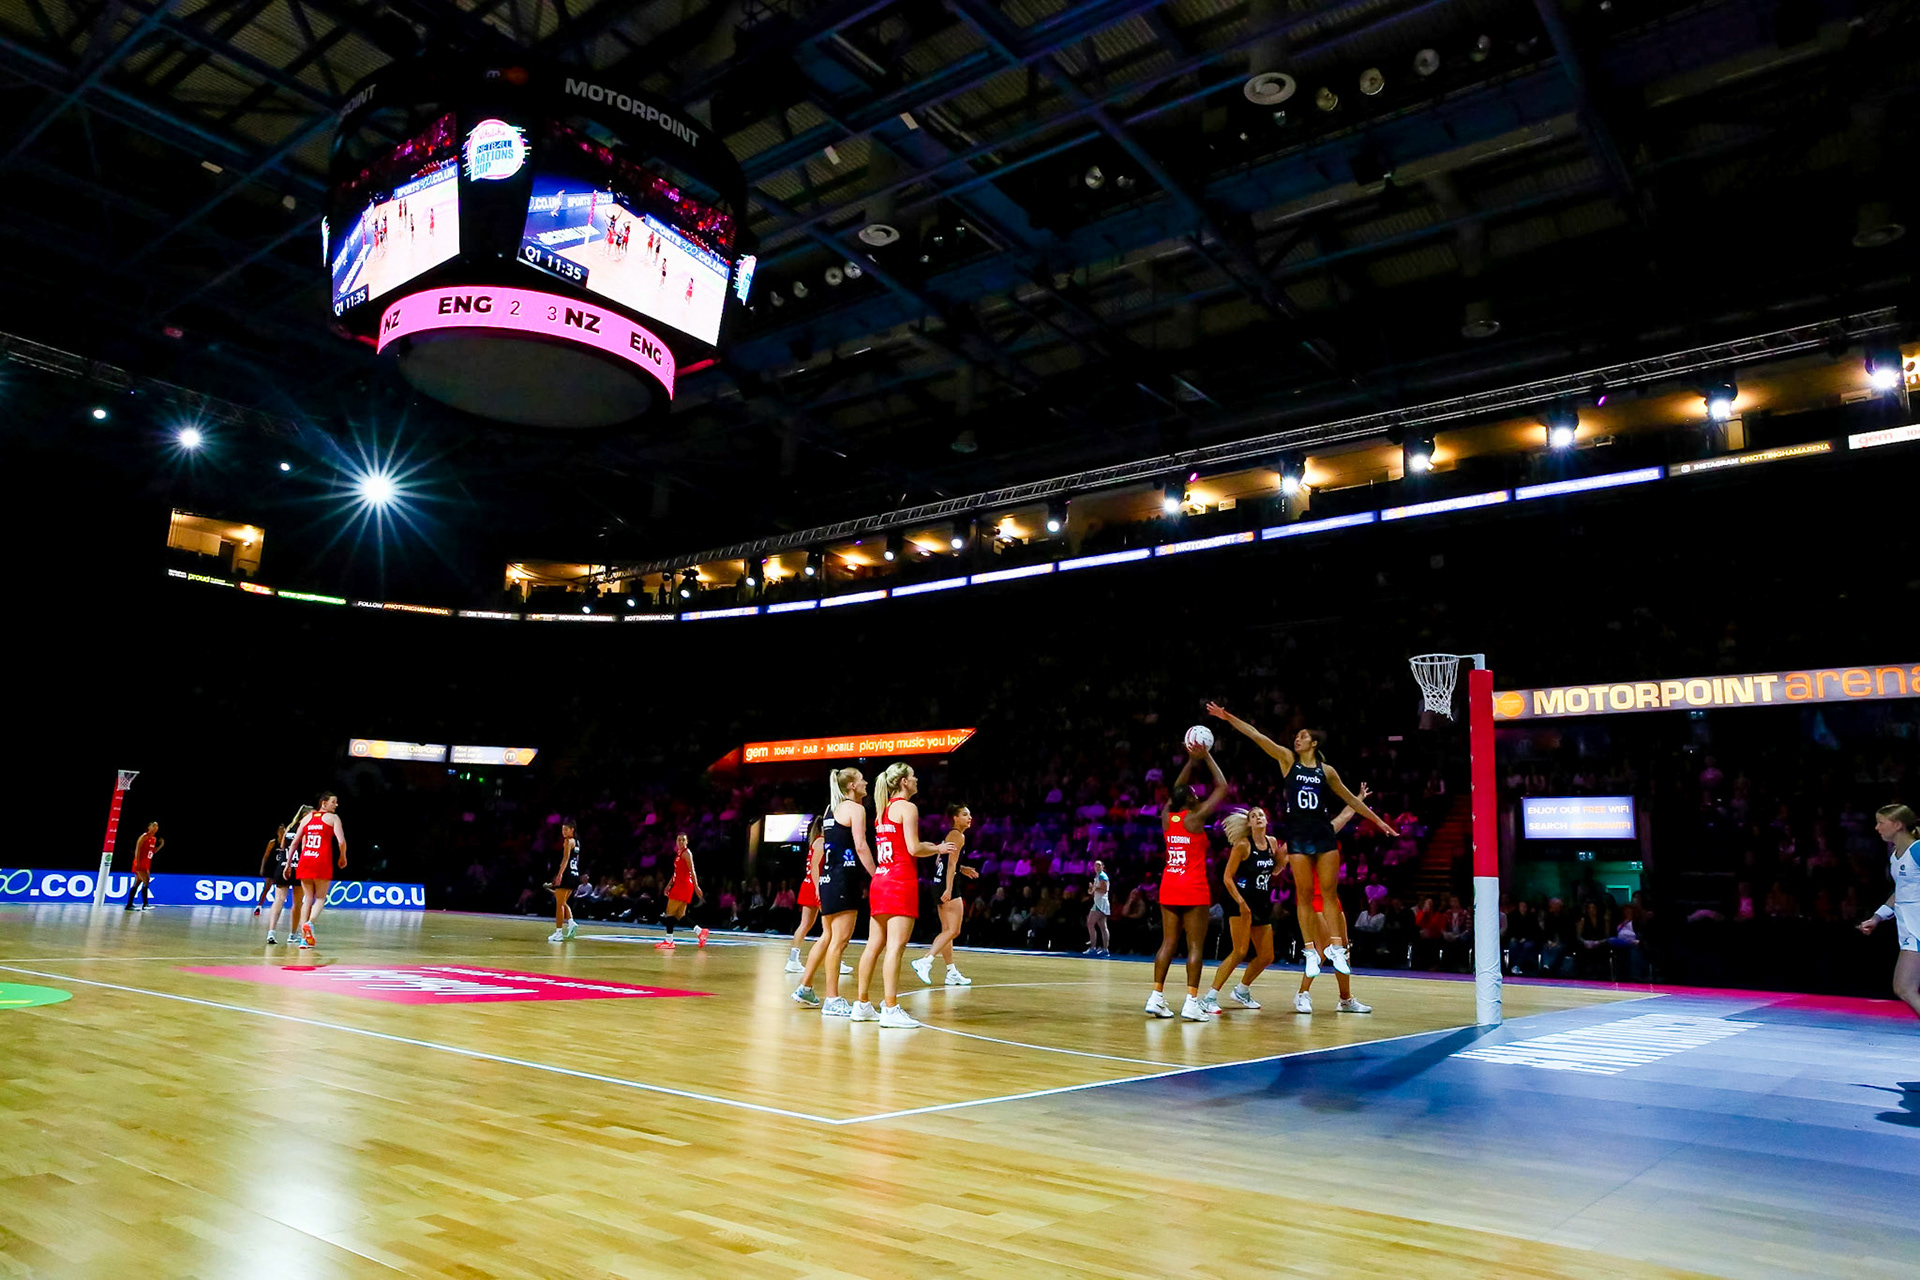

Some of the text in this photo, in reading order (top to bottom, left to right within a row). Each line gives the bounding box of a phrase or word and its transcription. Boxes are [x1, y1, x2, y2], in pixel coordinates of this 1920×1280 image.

[565, 78, 700, 147] MOTORPOINT
[475, 149, 514, 164] NATIONS
[474, 162, 491, 176] CUP
[525, 246, 582, 280] Q1 11:35
[346, 289, 366, 309] 11:35
[383, 309, 401, 335] NZ
[437, 295, 493, 315] ENG
[509, 300, 521, 316] 2
[547, 306, 557, 321] 3
[564, 307, 601, 334] NZ
[629, 331, 662, 366] ENG
[1858, 432, 1893, 448] gem
[1693, 442, 1831, 471] INSTAGRAM @NOTTINGHAMARENA
[1175, 535, 1237, 553] MOTORPOINT
[187, 573, 211, 583] proud
[357, 600, 449, 615] FOLLOW #NOTTINGHAMARENA
[1532, 674, 1778, 715] MOTORPOINT
[746, 747, 769, 761] gem
[774, 746, 795, 756] 106FM
[803, 745, 818, 754] DAB
[827, 743, 854, 753] MOBILE
[859, 739, 895, 753] playing
[896, 737, 924, 749] music
[927, 738, 945, 750] you
[1296, 774, 1321, 784] myob
[1297, 790, 1319, 810] GD
[1527, 805, 1630, 815] ENJOY OUR FREE WIFI
[1528, 822, 1568, 831] SEARCH
[306, 835, 322, 849] GD
